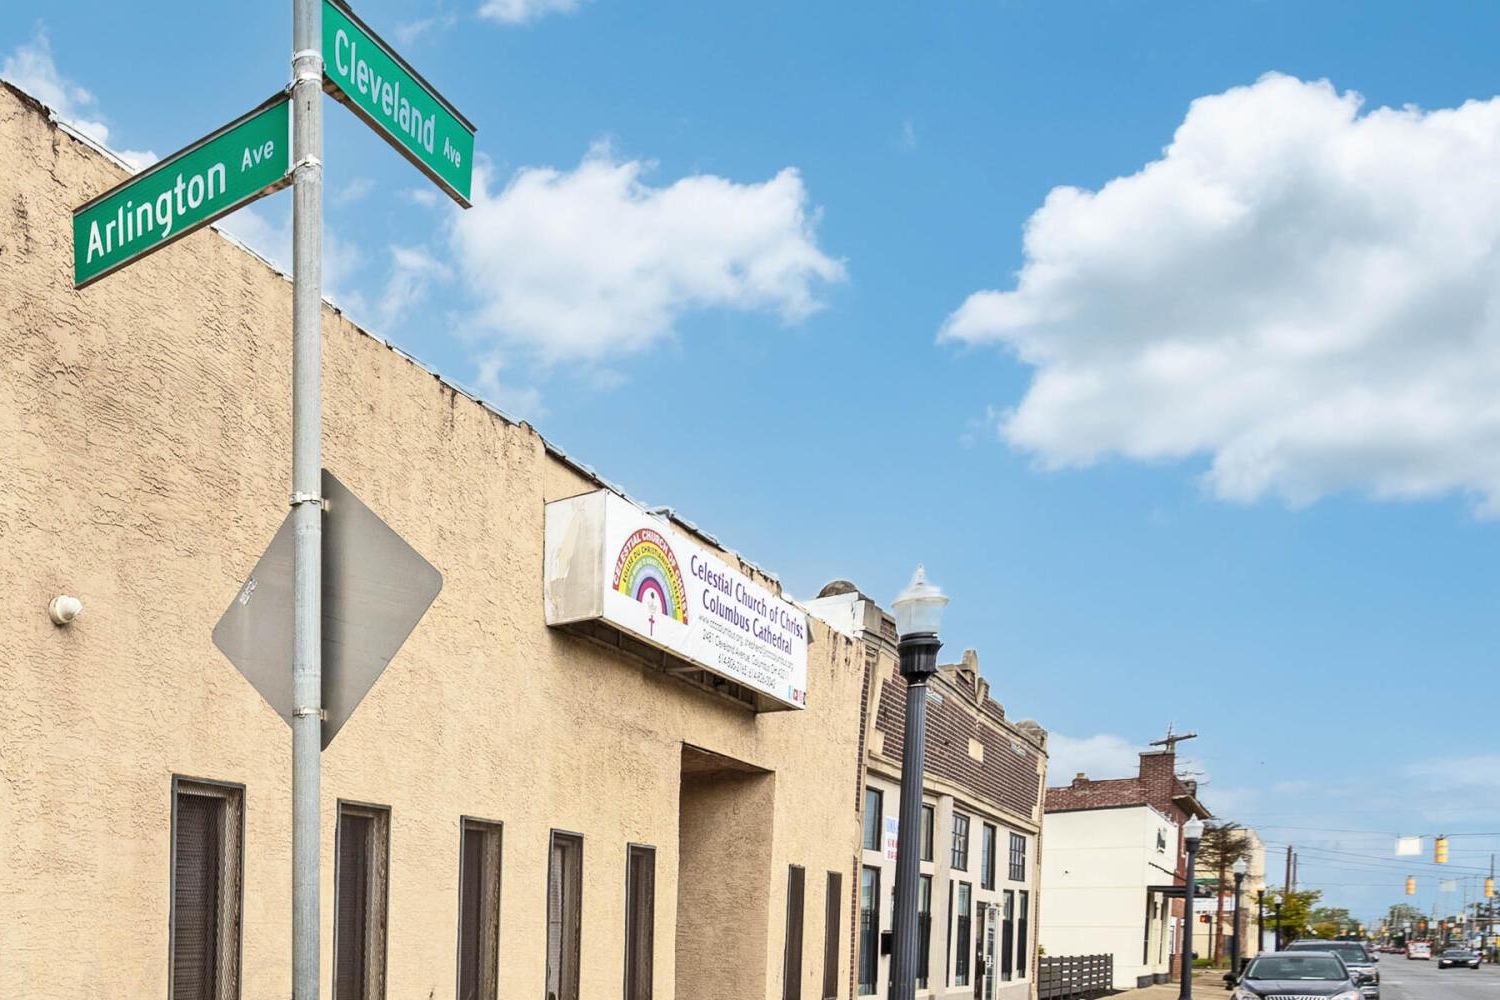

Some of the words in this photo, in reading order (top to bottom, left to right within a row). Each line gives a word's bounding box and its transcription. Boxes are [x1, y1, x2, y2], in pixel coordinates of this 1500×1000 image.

[334, 29, 436, 153] Cleveland
[443, 138, 461, 169] Ave
[86, 162, 226, 264] Arlington
[240, 139, 274, 173] Ave
[690, 554, 733, 597] Celestial
[735, 583, 767, 618] Church
[769, 606, 779, 625] of
[702, 588, 750, 633] Columbus
[752, 617, 792, 656] Cathedral
